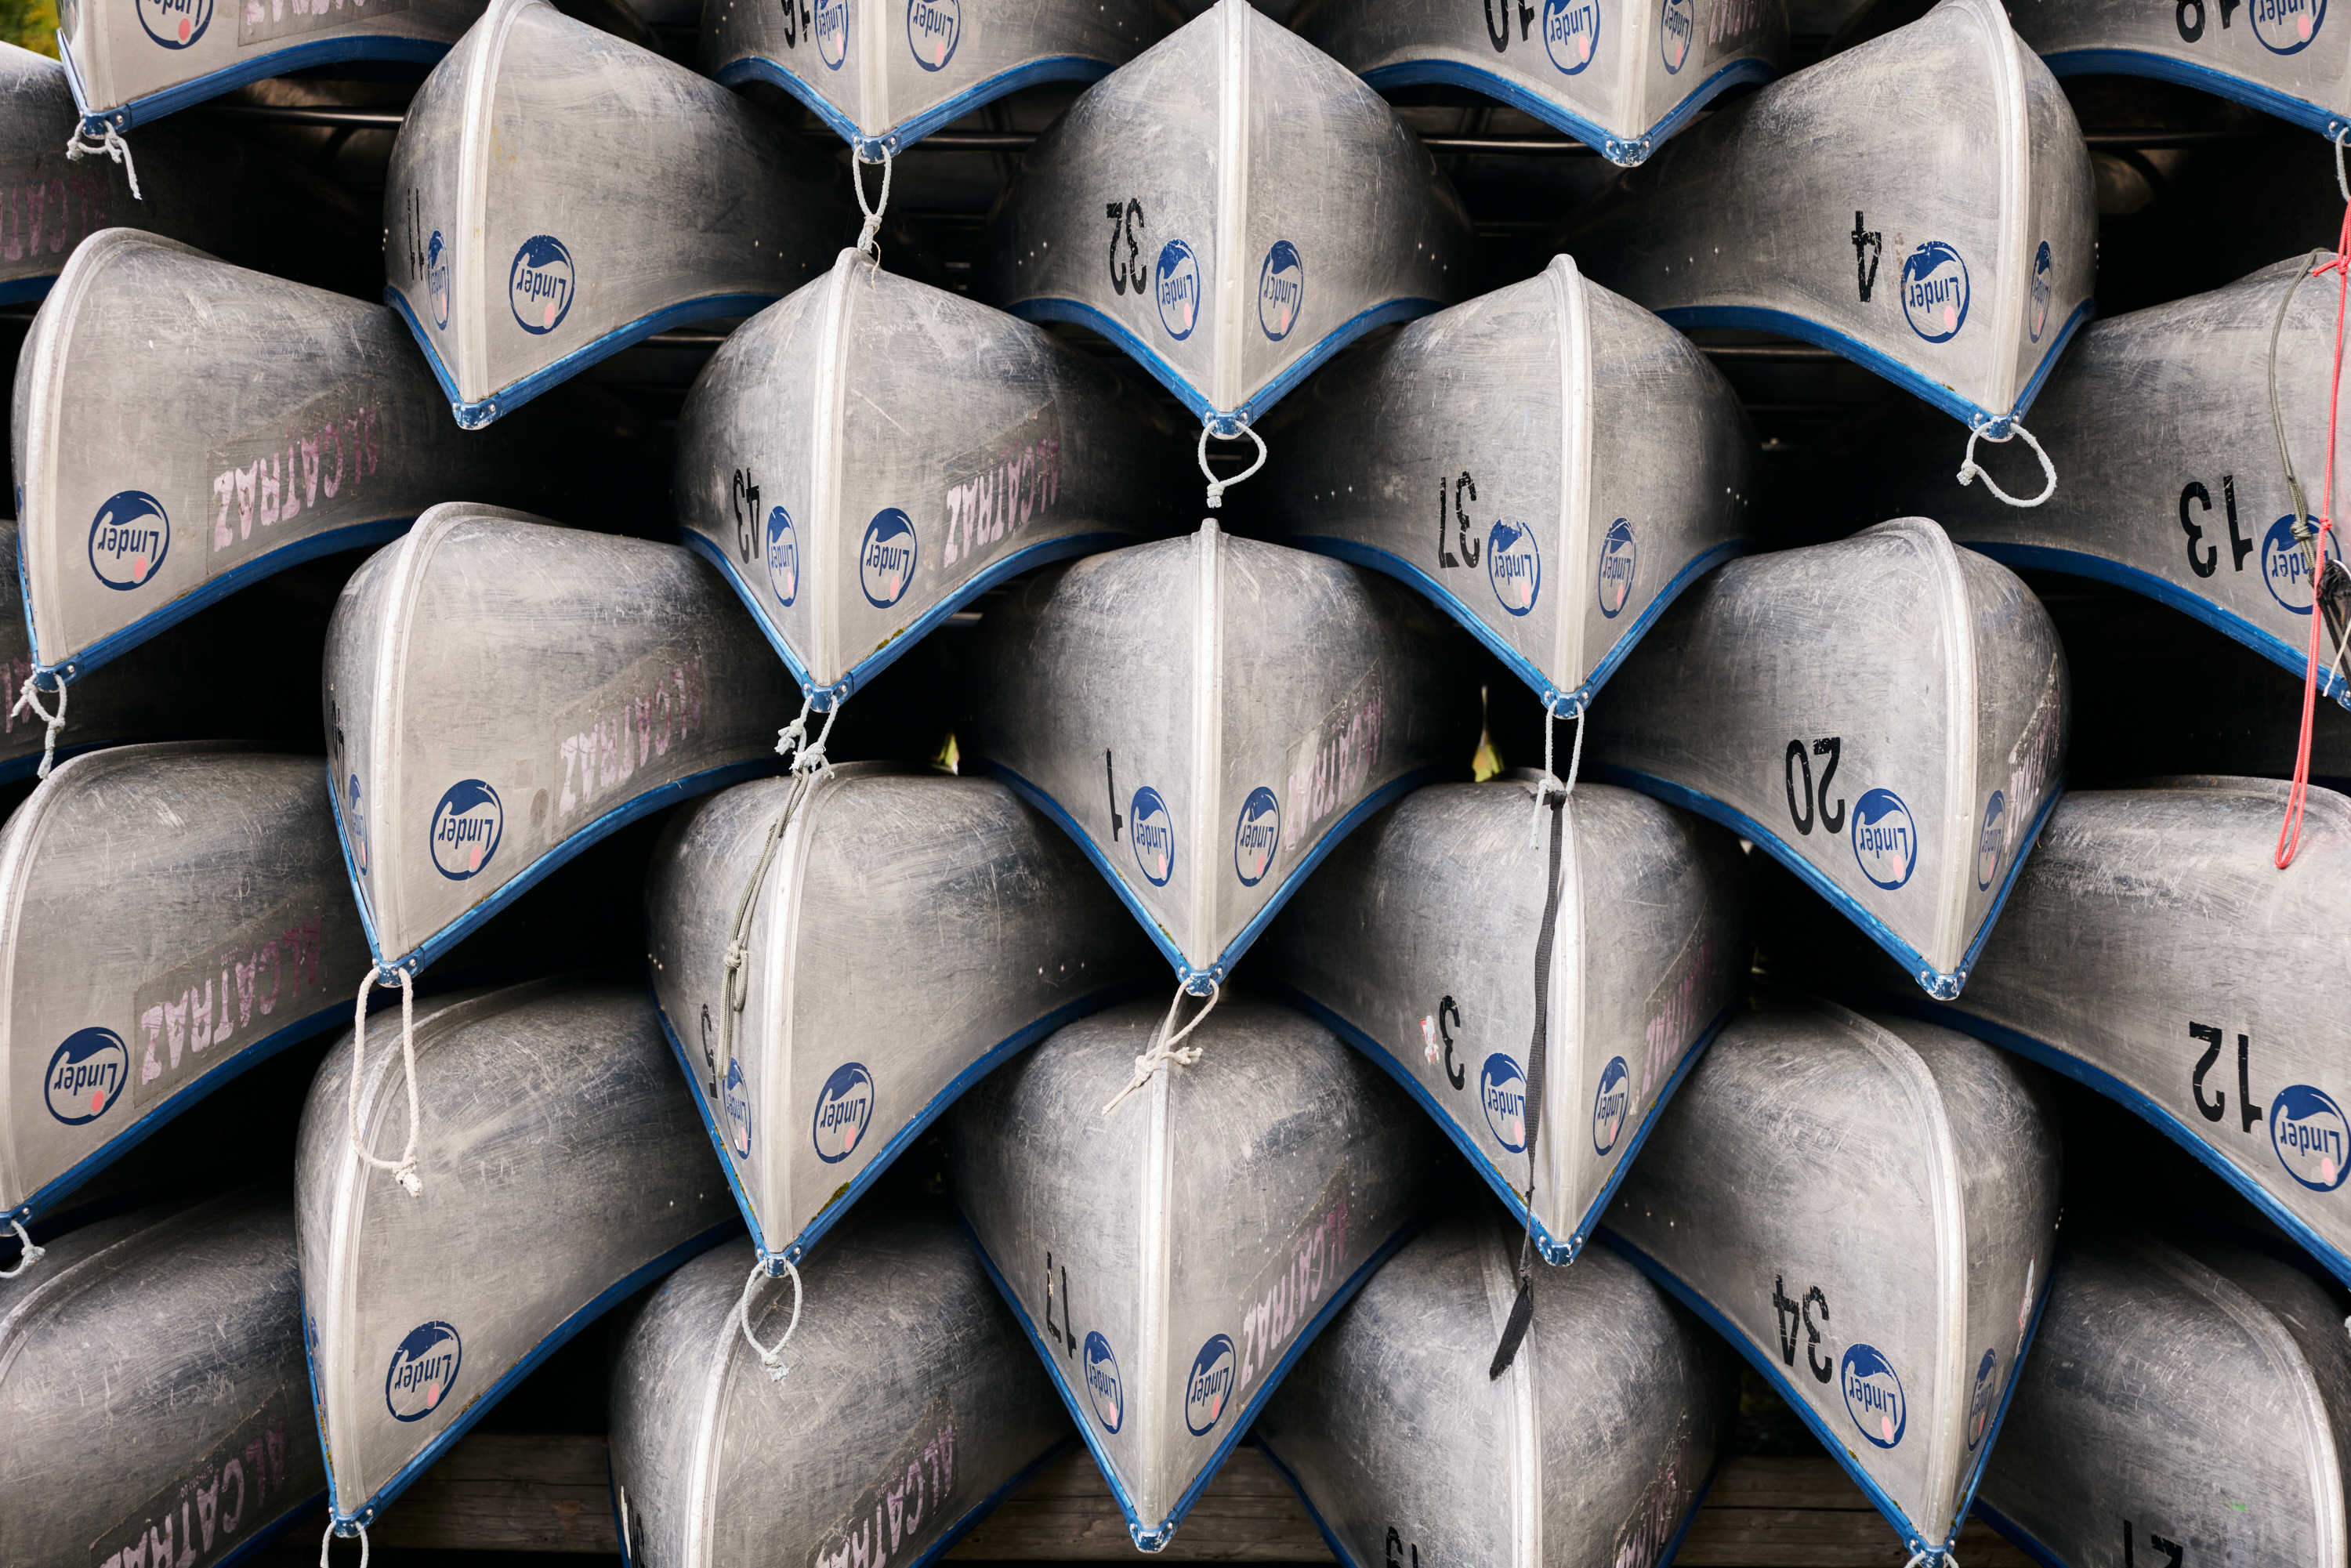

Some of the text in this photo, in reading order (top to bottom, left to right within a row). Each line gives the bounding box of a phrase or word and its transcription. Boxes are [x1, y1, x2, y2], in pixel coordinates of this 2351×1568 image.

[913, 2, 954, 49] Linder
[1551, 5, 1594, 45] Linder
[1663, 4, 1689, 50] Linder
[408, 188, 424, 281] 11
[1107, 197, 1147, 296] 32
[1851, 210, 1881, 302] 4
[516, 270, 567, 311] Linder
[1161, 274, 1194, 310] Linder
[1910, 277, 1961, 313] Linder
[215, 405, 379, 551] ALCATRAZ
[944, 435, 1062, 566] ALCATRAZ
[734, 467, 759, 564] 43
[1439, 470, 1480, 569] 37
[2179, 475, 2253, 578] 13
[98, 528, 159, 563] Linder
[771, 545, 795, 576] Linder
[866, 545, 910, 582] Linder
[1495, 554, 1533, 588] Linder
[1603, 556, 1631, 589] Linder
[560, 654, 701, 817] ALCATRAZ
[1106, 748, 1123, 842] 1
[1785, 737, 1845, 835] 20
[438, 818, 493, 851] Linder
[1136, 823, 1168, 860] Linder
[1240, 825, 1274, 858] Linder
[1860, 828, 1908, 860] Linder
[141, 914, 321, 1084] ALCATRAZ
[1439, 995, 1464, 1091] 3
[54, 1063, 117, 1095] Linder
[2189, 1021, 2263, 1133] 12
[820, 1098, 866, 1133] Linder
[1488, 1088, 1525, 1121] Linder
[1597, 1092, 1625, 1126] Linder
[2280, 1121, 2340, 1165] Linder
[1046, 1251, 1076, 1360] 17
[1773, 1273, 1832, 1384] 34
[395, 1354, 451, 1392] Linder
[1089, 1364, 1118, 1410] Linder
[1191, 1367, 1229, 1407] Linder
[1849, 1377, 1896, 1426] Linder
[100, 1417, 286, 1568] ALCATR
